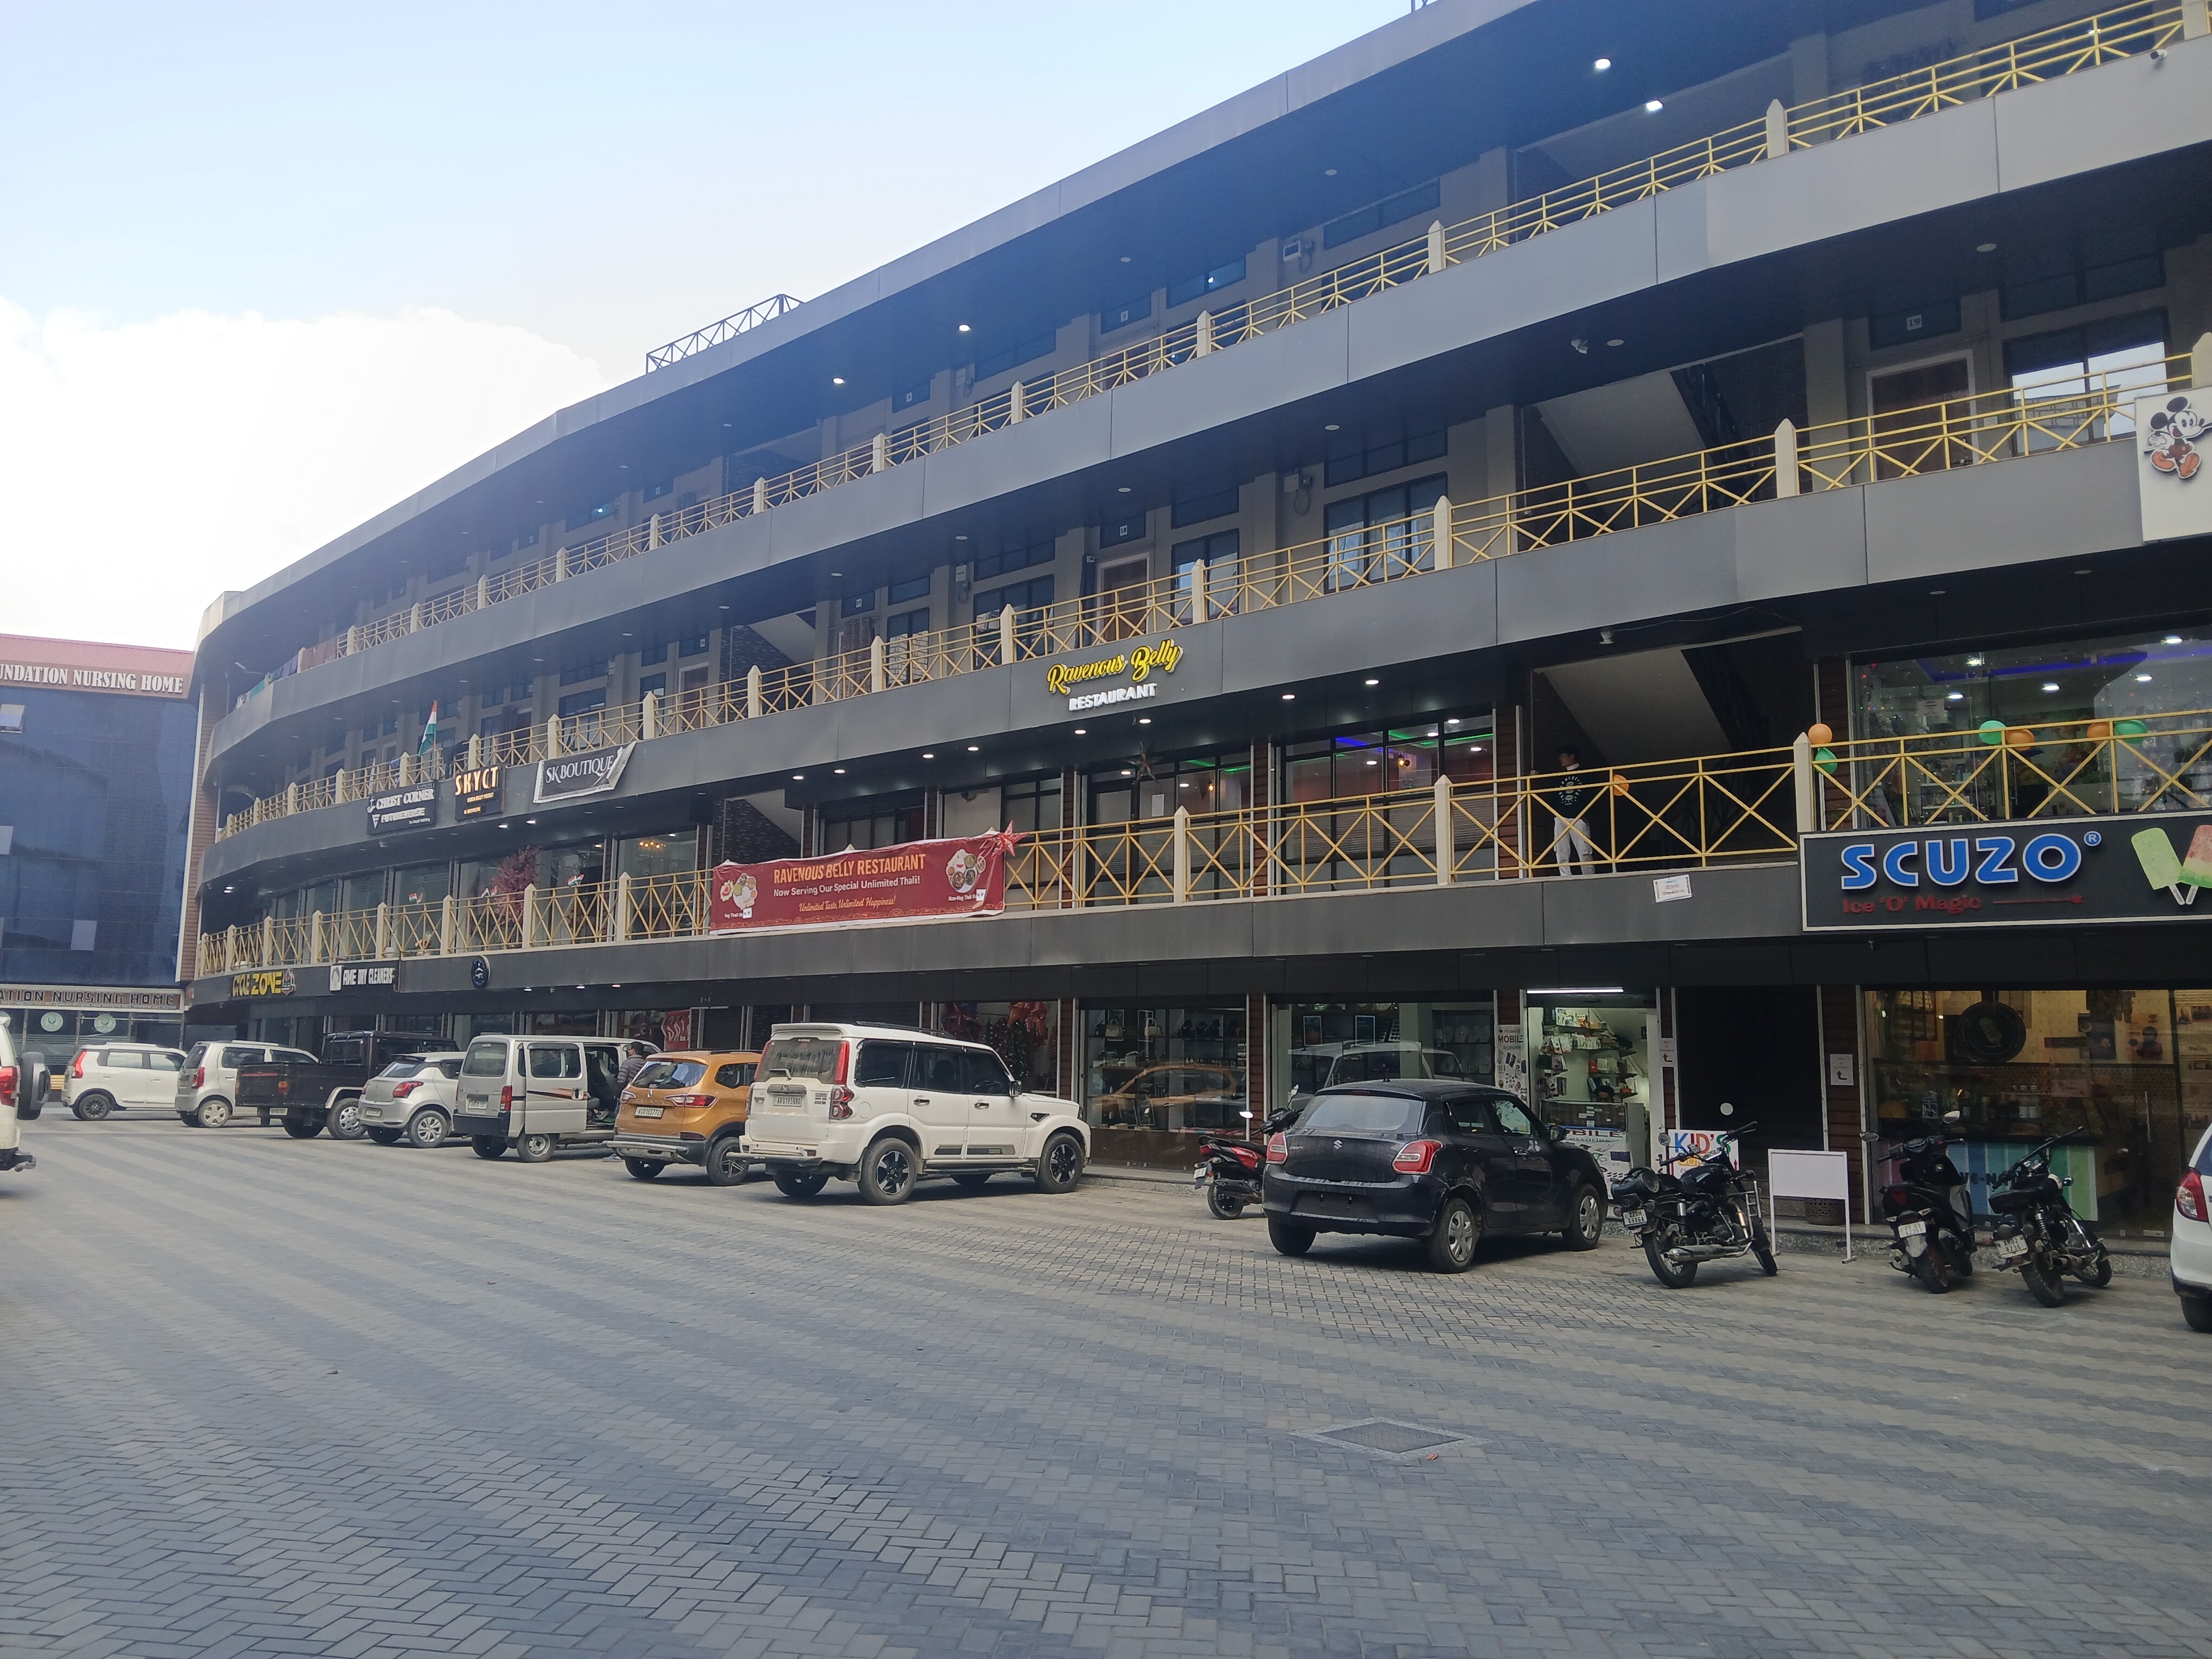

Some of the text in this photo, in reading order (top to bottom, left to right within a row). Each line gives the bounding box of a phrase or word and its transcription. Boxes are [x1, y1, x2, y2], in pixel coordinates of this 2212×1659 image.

[1046, 638, 1183, 696] Ravenous Belly
[73, 669, 136, 690] NURSING
[140, 674, 183, 693] HOME
[1069, 683, 1158, 711] RESTAURANT
[376, 788, 434, 810] CHRIST CORNER
[774, 854, 926, 884] RAVENOUS BELLY RESTAURANT
[1841, 833, 2082, 890] SCUZO
[773, 875, 920, 897] Now Serving Our Special Unlimited Thali!
[1843, 898, 1875, 914] Ice
[1915, 895, 1982, 915] Magic
[251, 971, 282, 995] ZONE
[357, 968, 368, 985] DRY
[368, 967, 393, 984] CLEANERS
[53, 992, 123, 1004] NURSING
[130, 993, 174, 1005] HOME
[1565, 1129, 1623, 1138] BILE
